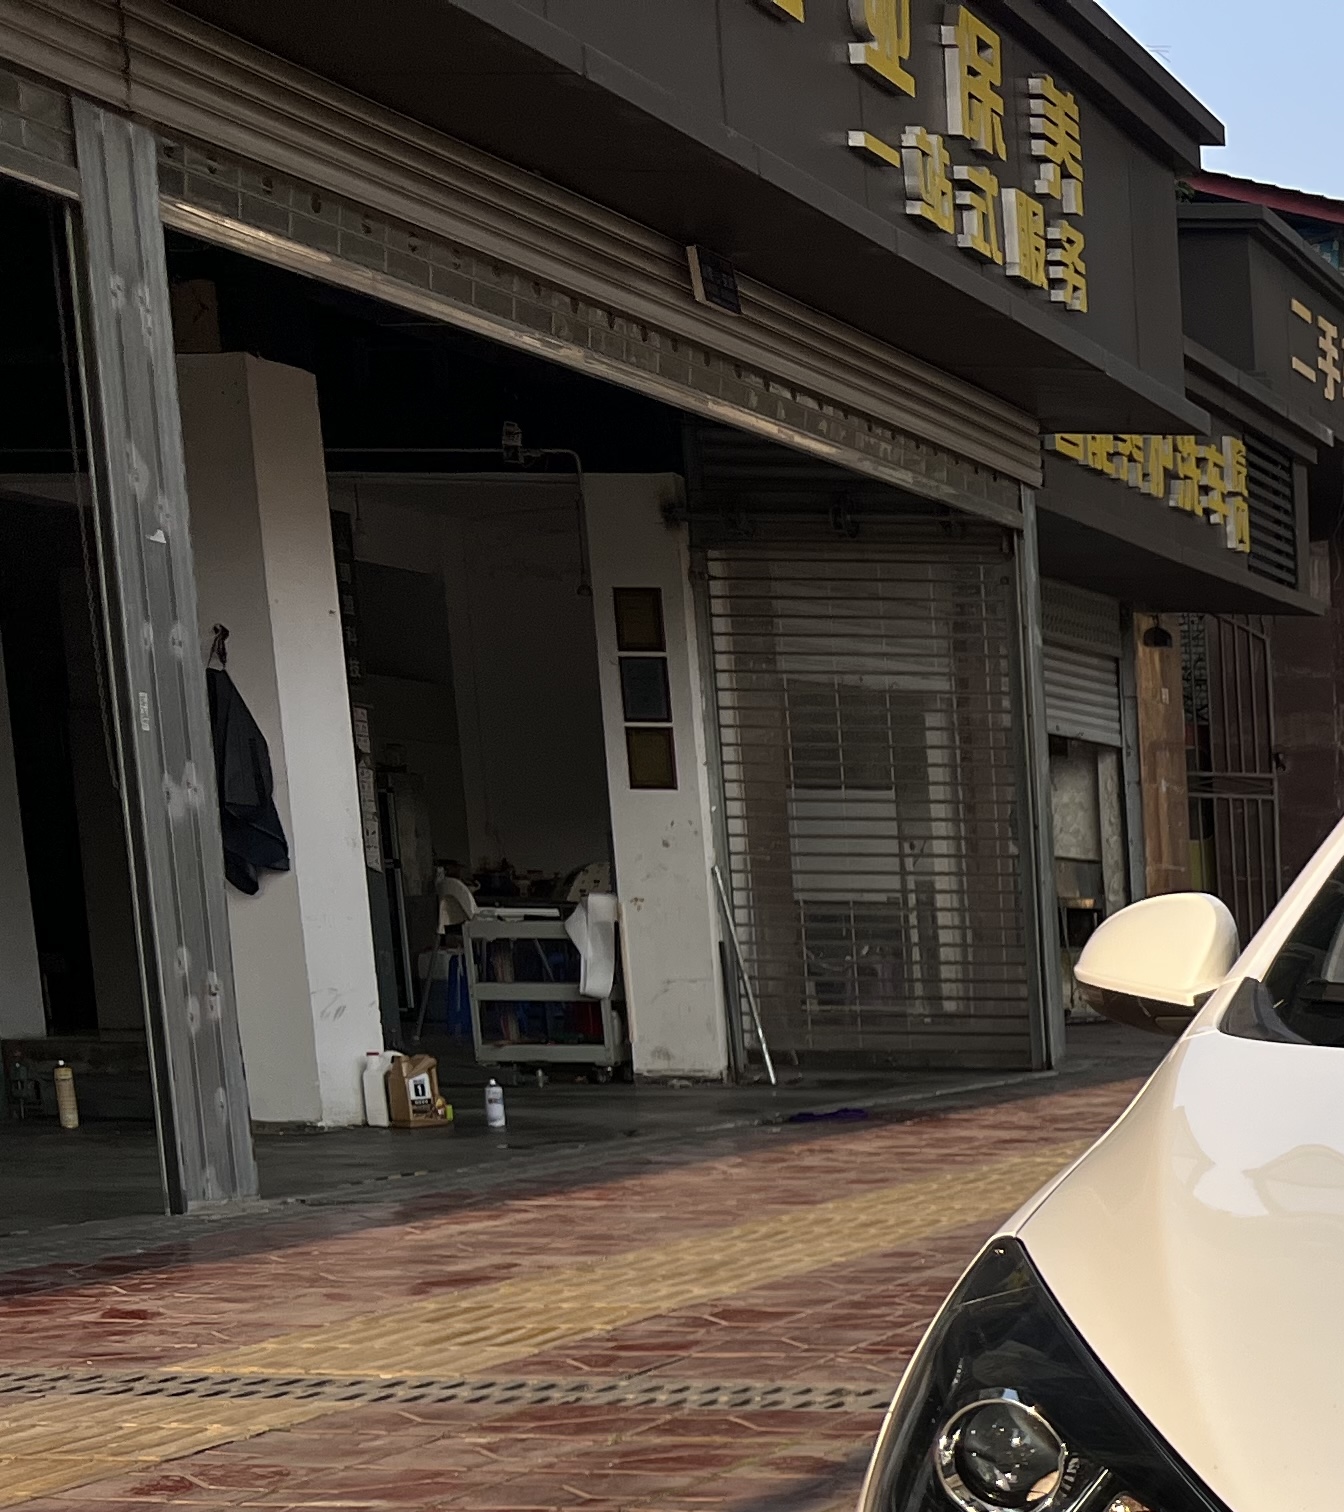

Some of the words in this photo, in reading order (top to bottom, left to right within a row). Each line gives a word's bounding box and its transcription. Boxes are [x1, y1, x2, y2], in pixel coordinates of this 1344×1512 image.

[847, 125, 1088, 313] 一站式服务
